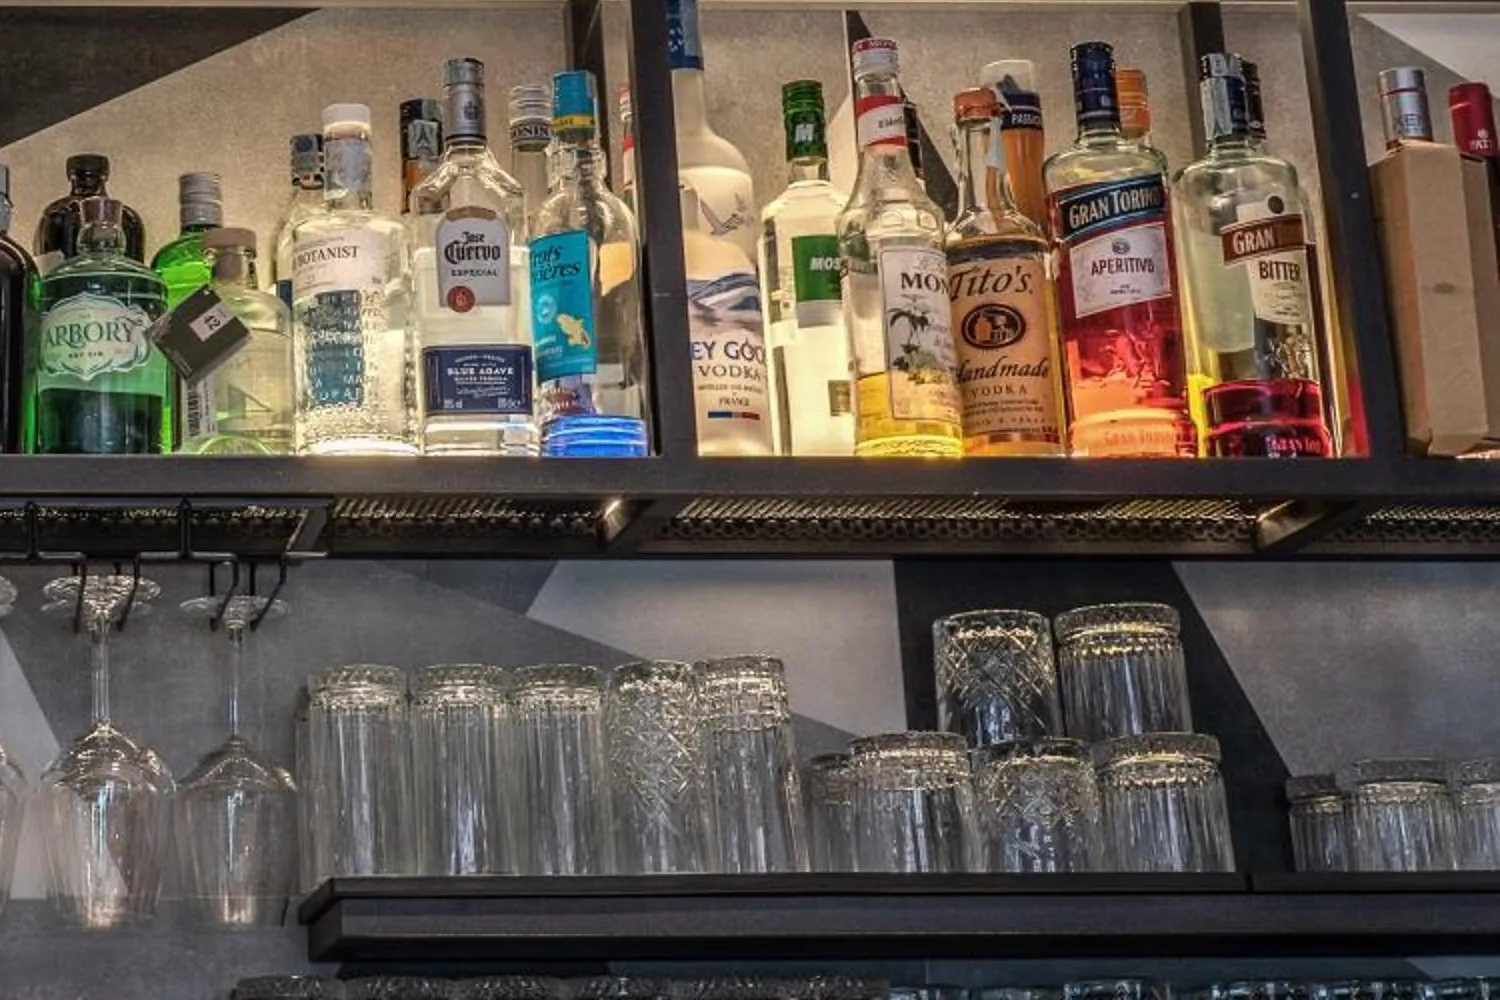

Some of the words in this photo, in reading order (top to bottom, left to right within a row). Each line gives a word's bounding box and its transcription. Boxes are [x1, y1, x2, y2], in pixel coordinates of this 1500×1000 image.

[1069, 199, 1109, 229] GRAN
[462, 230, 485, 243] Jose
[1232, 225, 1275, 256] GRAN
[297, 246, 359, 266] BOTANIST
[444, 239, 501, 264] Cuervo
[451, 269, 498, 278] ESPECIAL
[1091, 256, 1156, 277] APERITIVO
[1258, 258, 1301, 281] BITTER
[950, 265, 1032, 302] Tito's
[691, 341, 716, 361] EY
[724, 338, 766, 365] GOO
[447, 367, 476, 376] BLUE
[479, 367, 515, 376] AGAVE
[698, 364, 762, 381] VODKA
